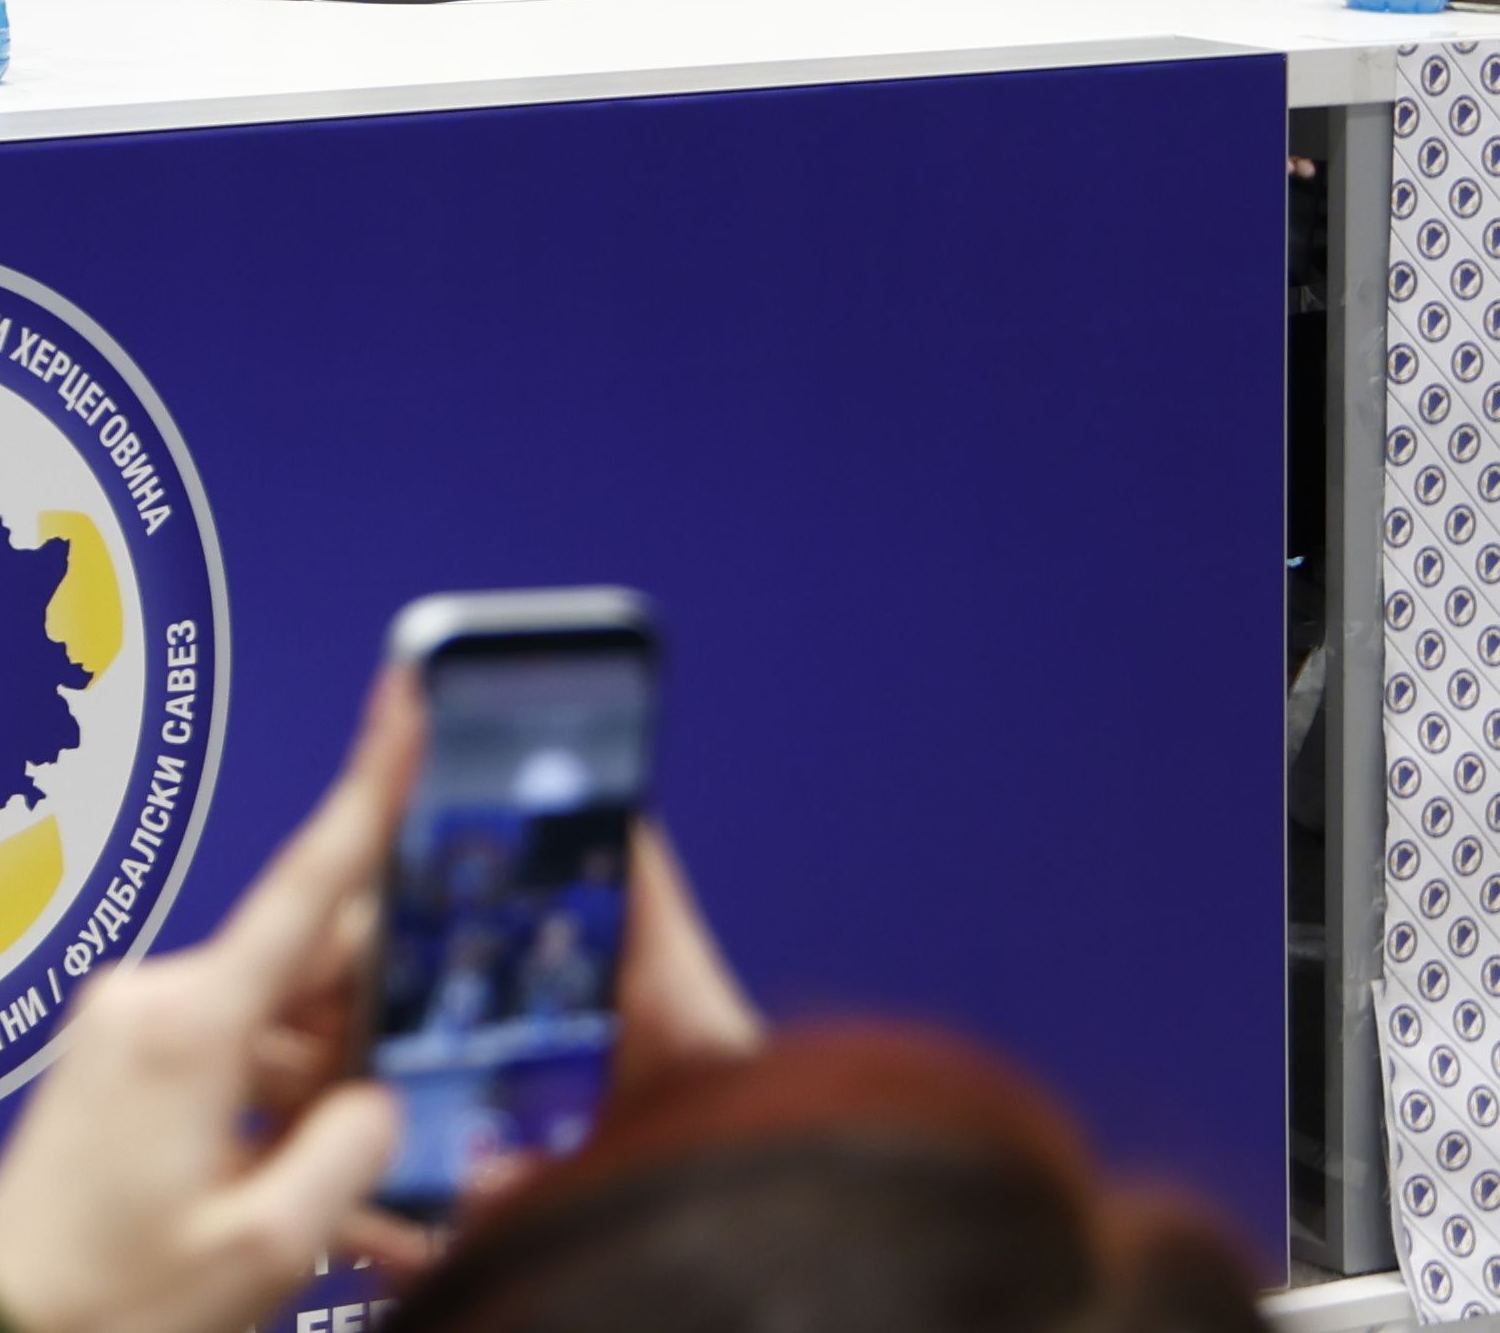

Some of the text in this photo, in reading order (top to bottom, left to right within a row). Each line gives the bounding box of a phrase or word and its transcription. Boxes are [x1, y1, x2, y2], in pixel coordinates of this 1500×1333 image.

[9, 327, 174, 538] ХЕРЦЕГОВИНА
[61, 755, 186, 978] ФУДБАЛСКИ
[160, 618, 199, 746] САВЕЗ
